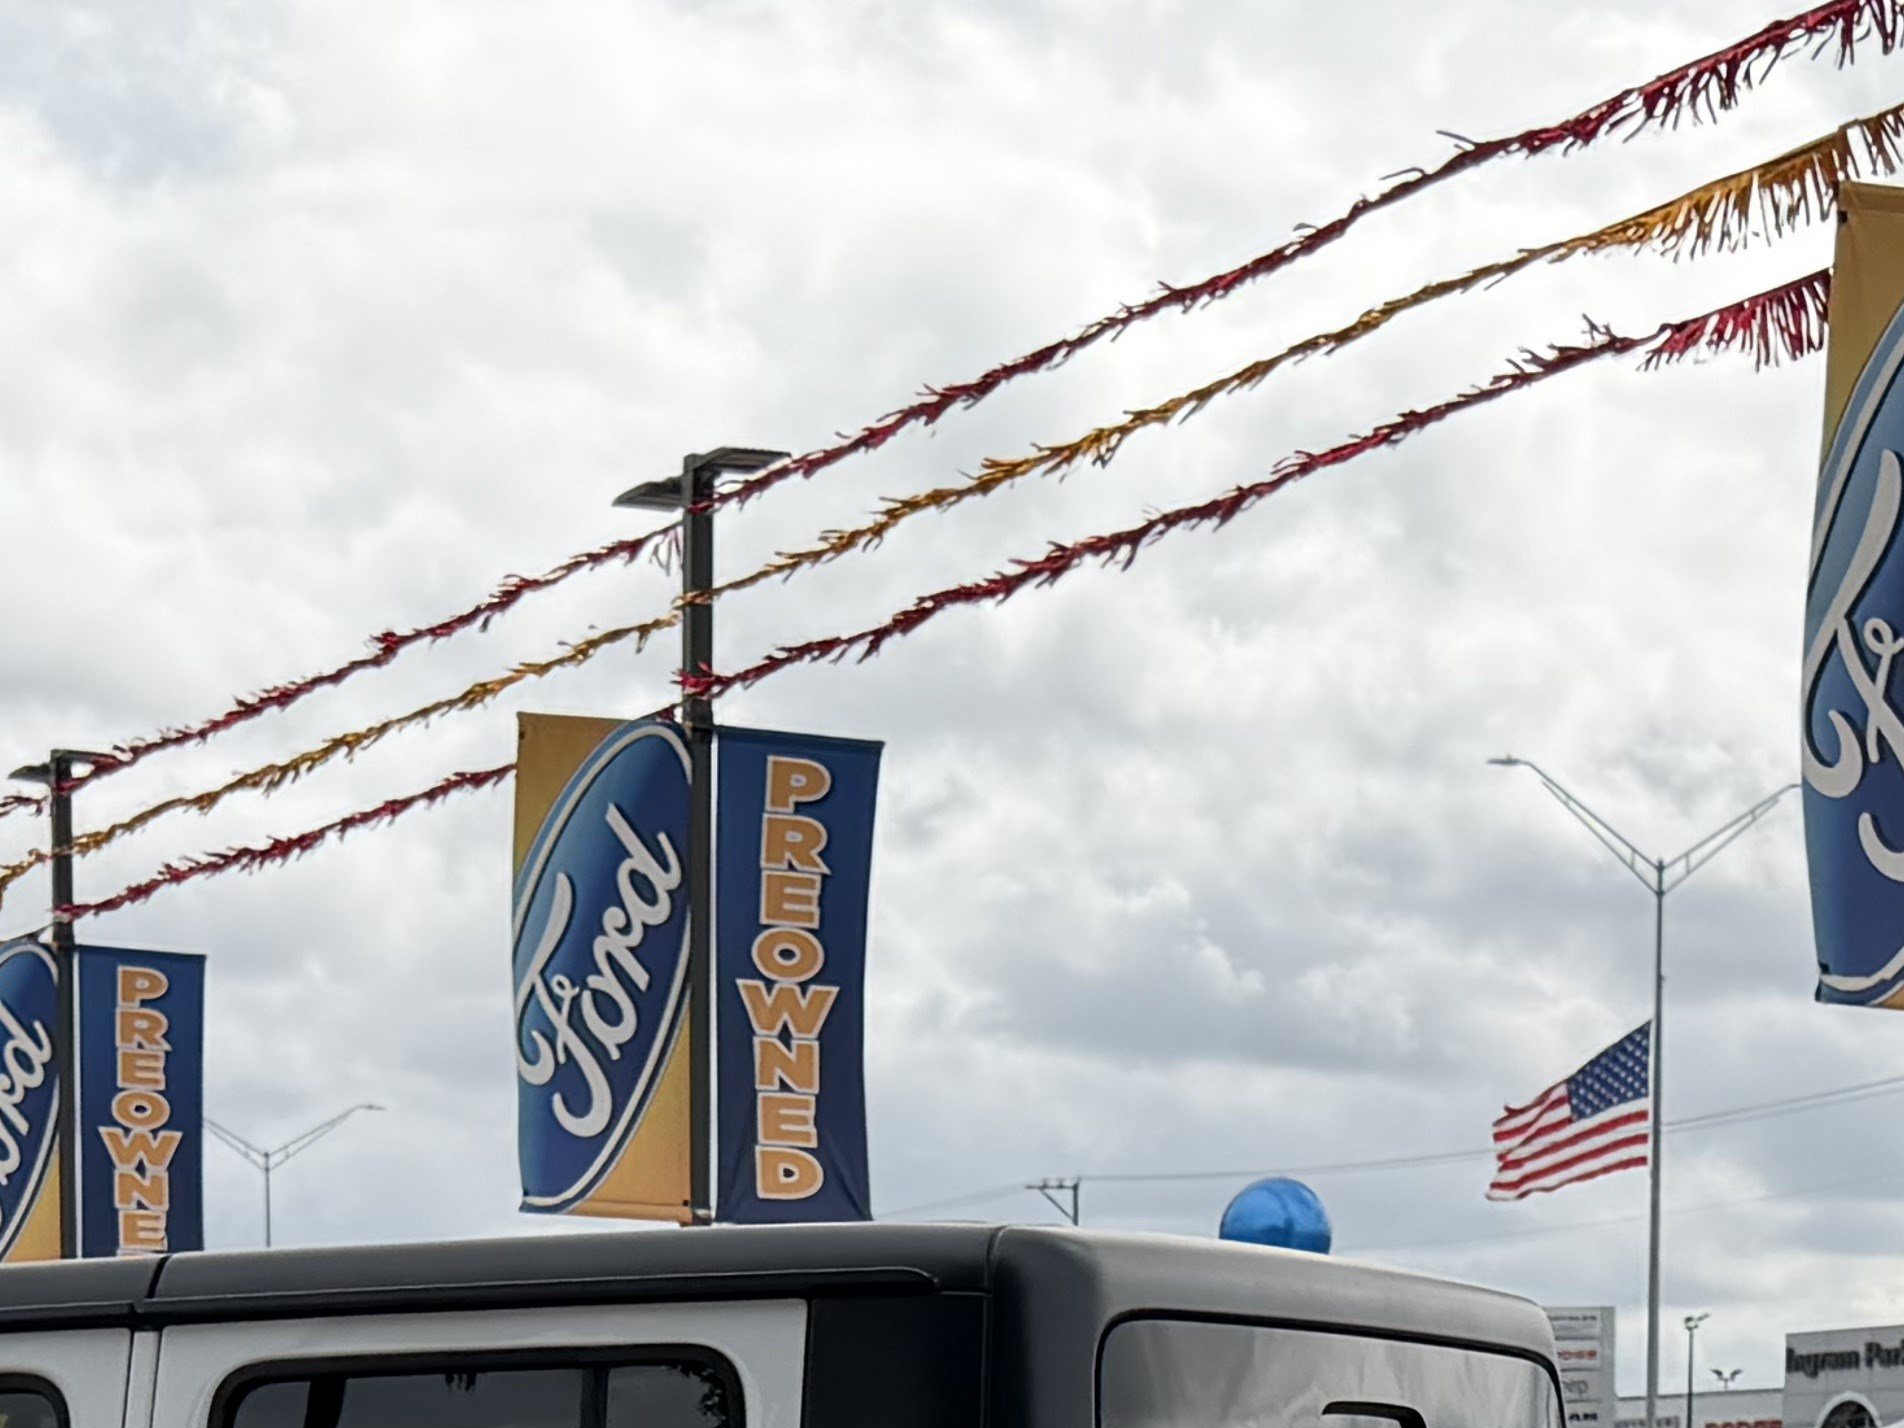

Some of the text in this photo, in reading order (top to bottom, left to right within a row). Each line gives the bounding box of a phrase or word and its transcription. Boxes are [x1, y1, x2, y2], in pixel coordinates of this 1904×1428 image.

[97, 966, 182, 1256] PREOWNE
[517, 803, 682, 1138] Ford
[736, 755, 839, 1200] PREOWNED
